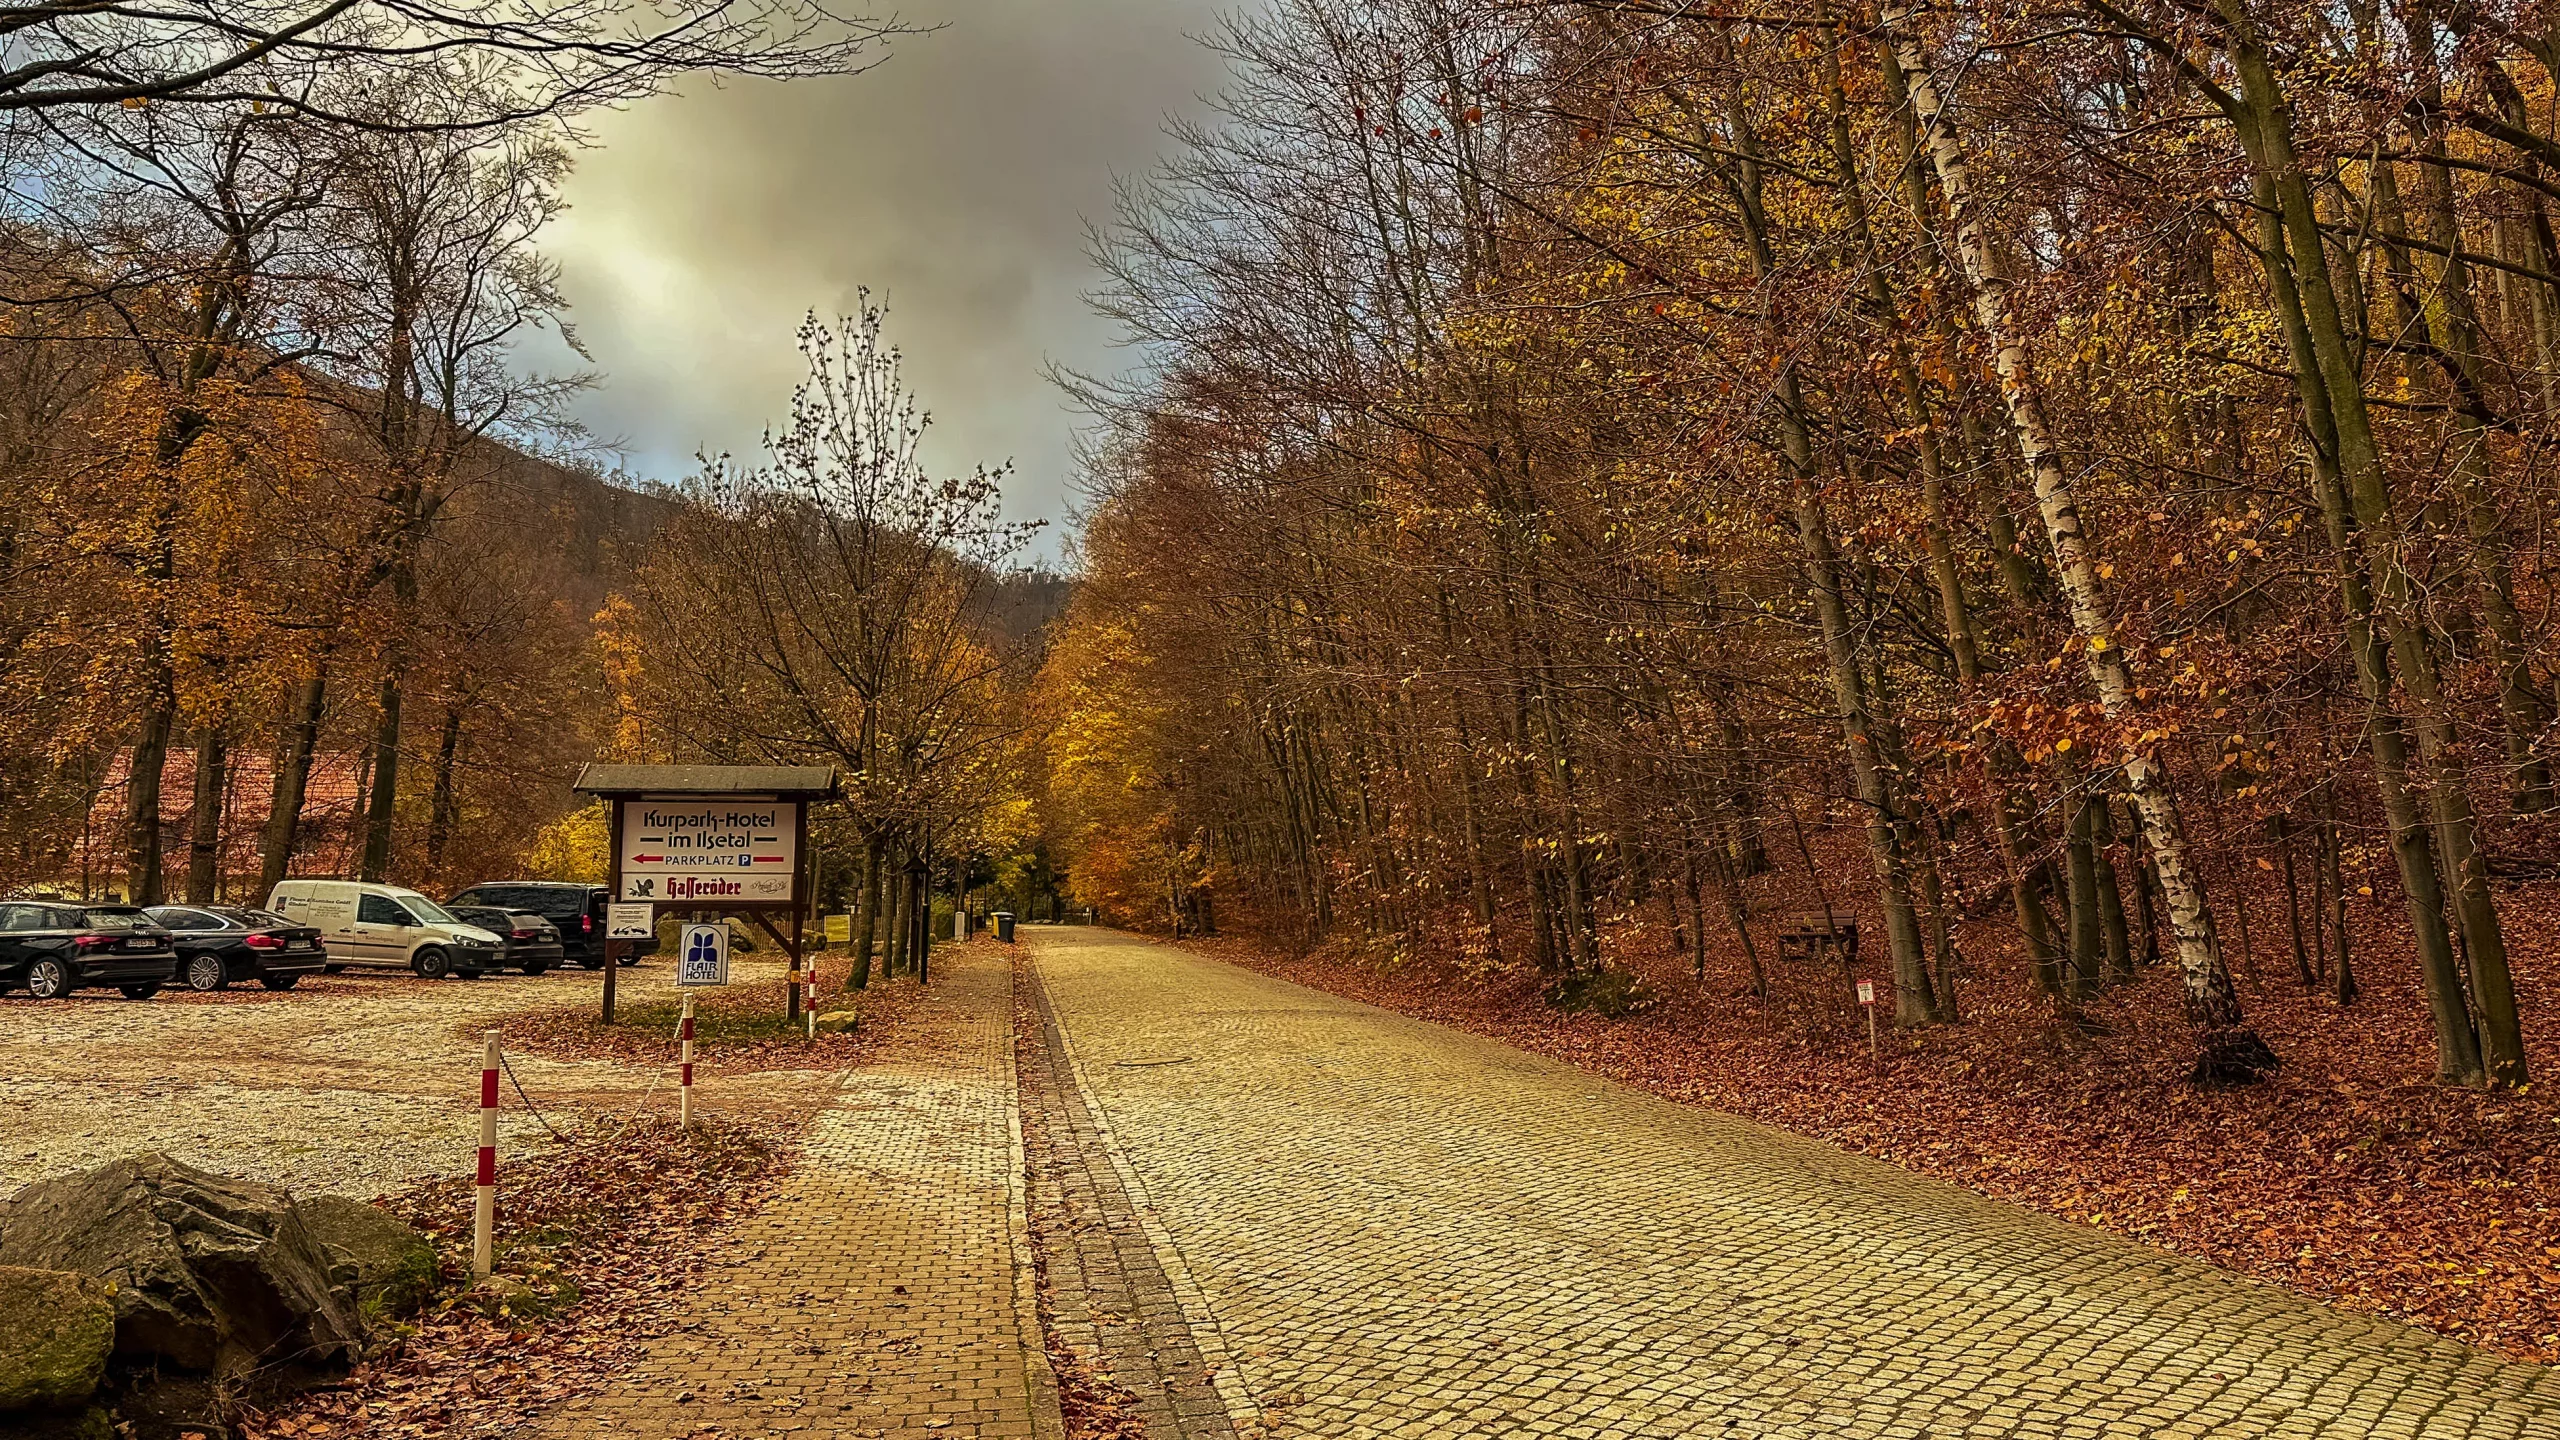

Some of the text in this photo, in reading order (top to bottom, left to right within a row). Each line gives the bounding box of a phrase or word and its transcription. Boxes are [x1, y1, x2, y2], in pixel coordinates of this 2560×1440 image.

[643, 810, 776, 832] Kurpark-Hotel
[668, 831, 750, 849] im Ilsetal
[665, 855, 734, 865] PARKPLATZ
[666, 877, 742, 899] Hasseröder
[687, 963, 717, 971] FLAIR
[685, 971, 718, 979] HOTEL
